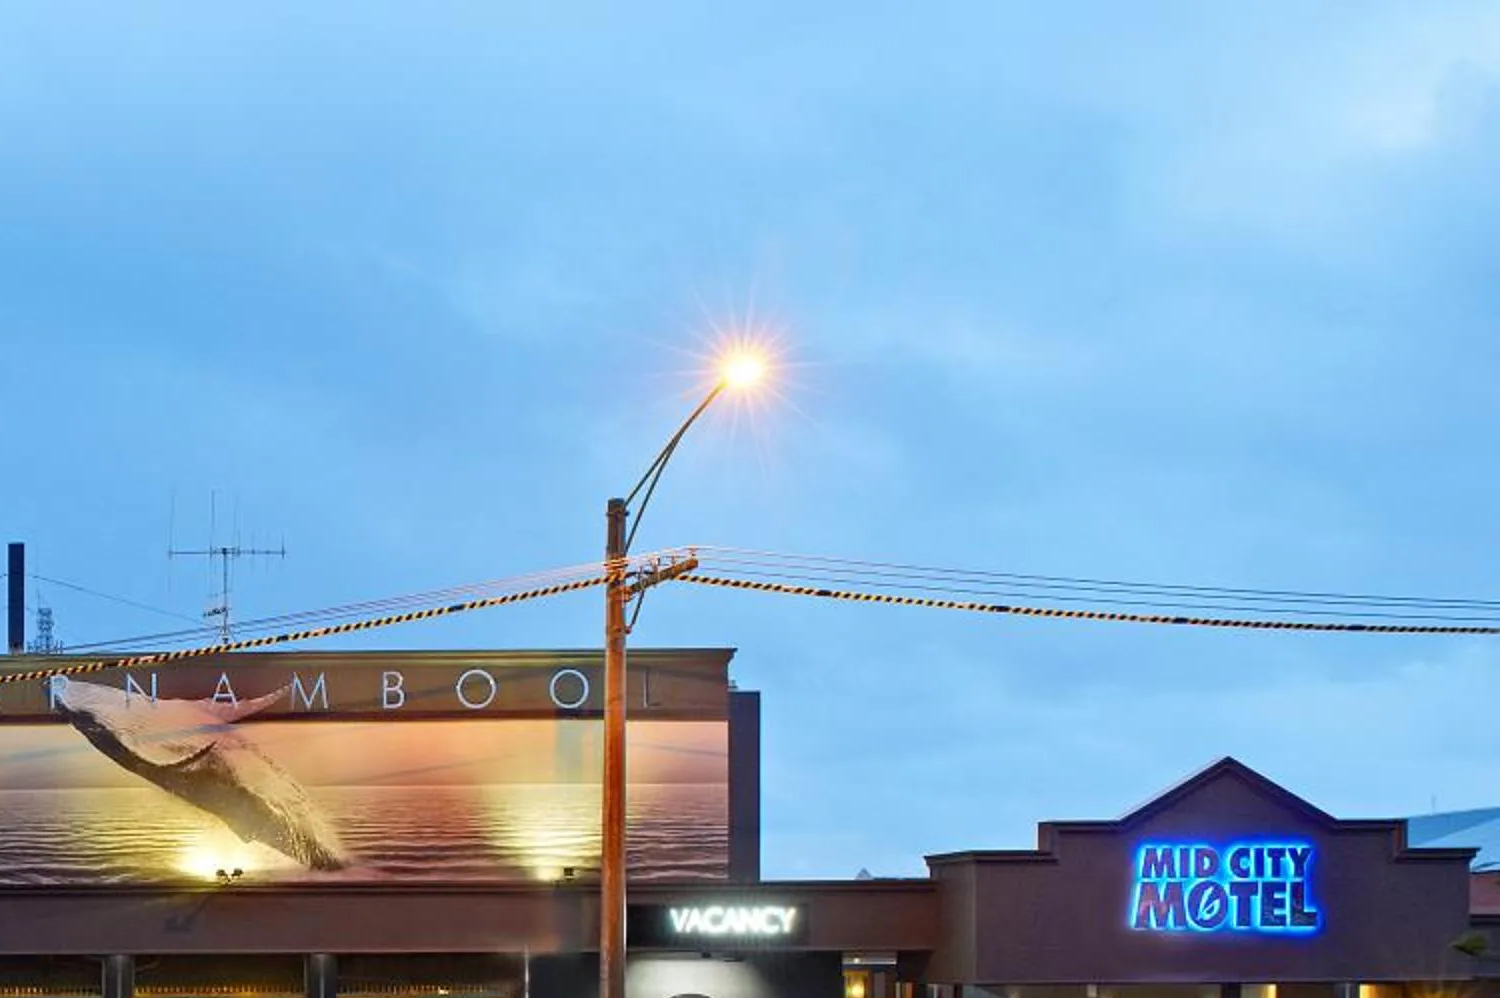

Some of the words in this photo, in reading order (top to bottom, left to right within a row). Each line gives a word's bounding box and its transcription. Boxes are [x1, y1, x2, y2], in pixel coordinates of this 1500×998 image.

[1142, 847, 1220, 879] MID
[1230, 847, 1313, 879] CITY
[669, 906, 796, 933] VACANCY
[1134, 880, 1318, 929] MOTEL
